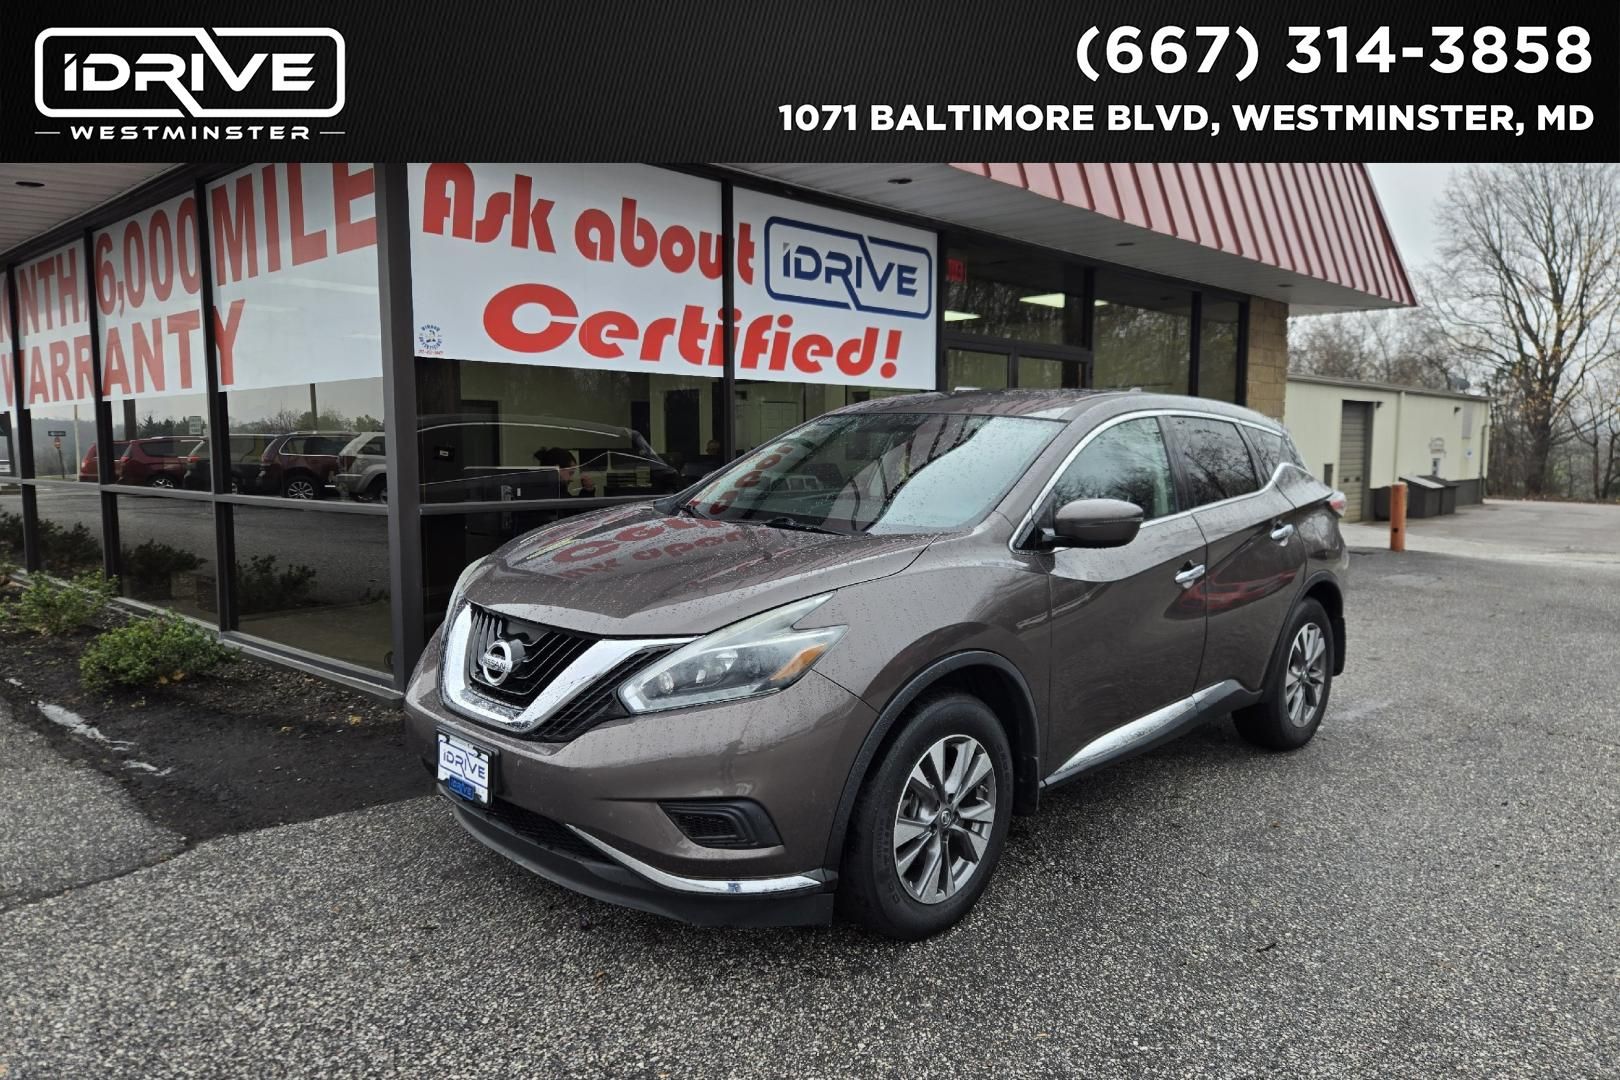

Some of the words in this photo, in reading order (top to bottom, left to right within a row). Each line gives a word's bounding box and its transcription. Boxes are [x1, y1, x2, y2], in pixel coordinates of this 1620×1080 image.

[422, 163, 556, 253] Ask
[574, 197, 756, 286] about
[483, 283, 903, 380] Certified!
